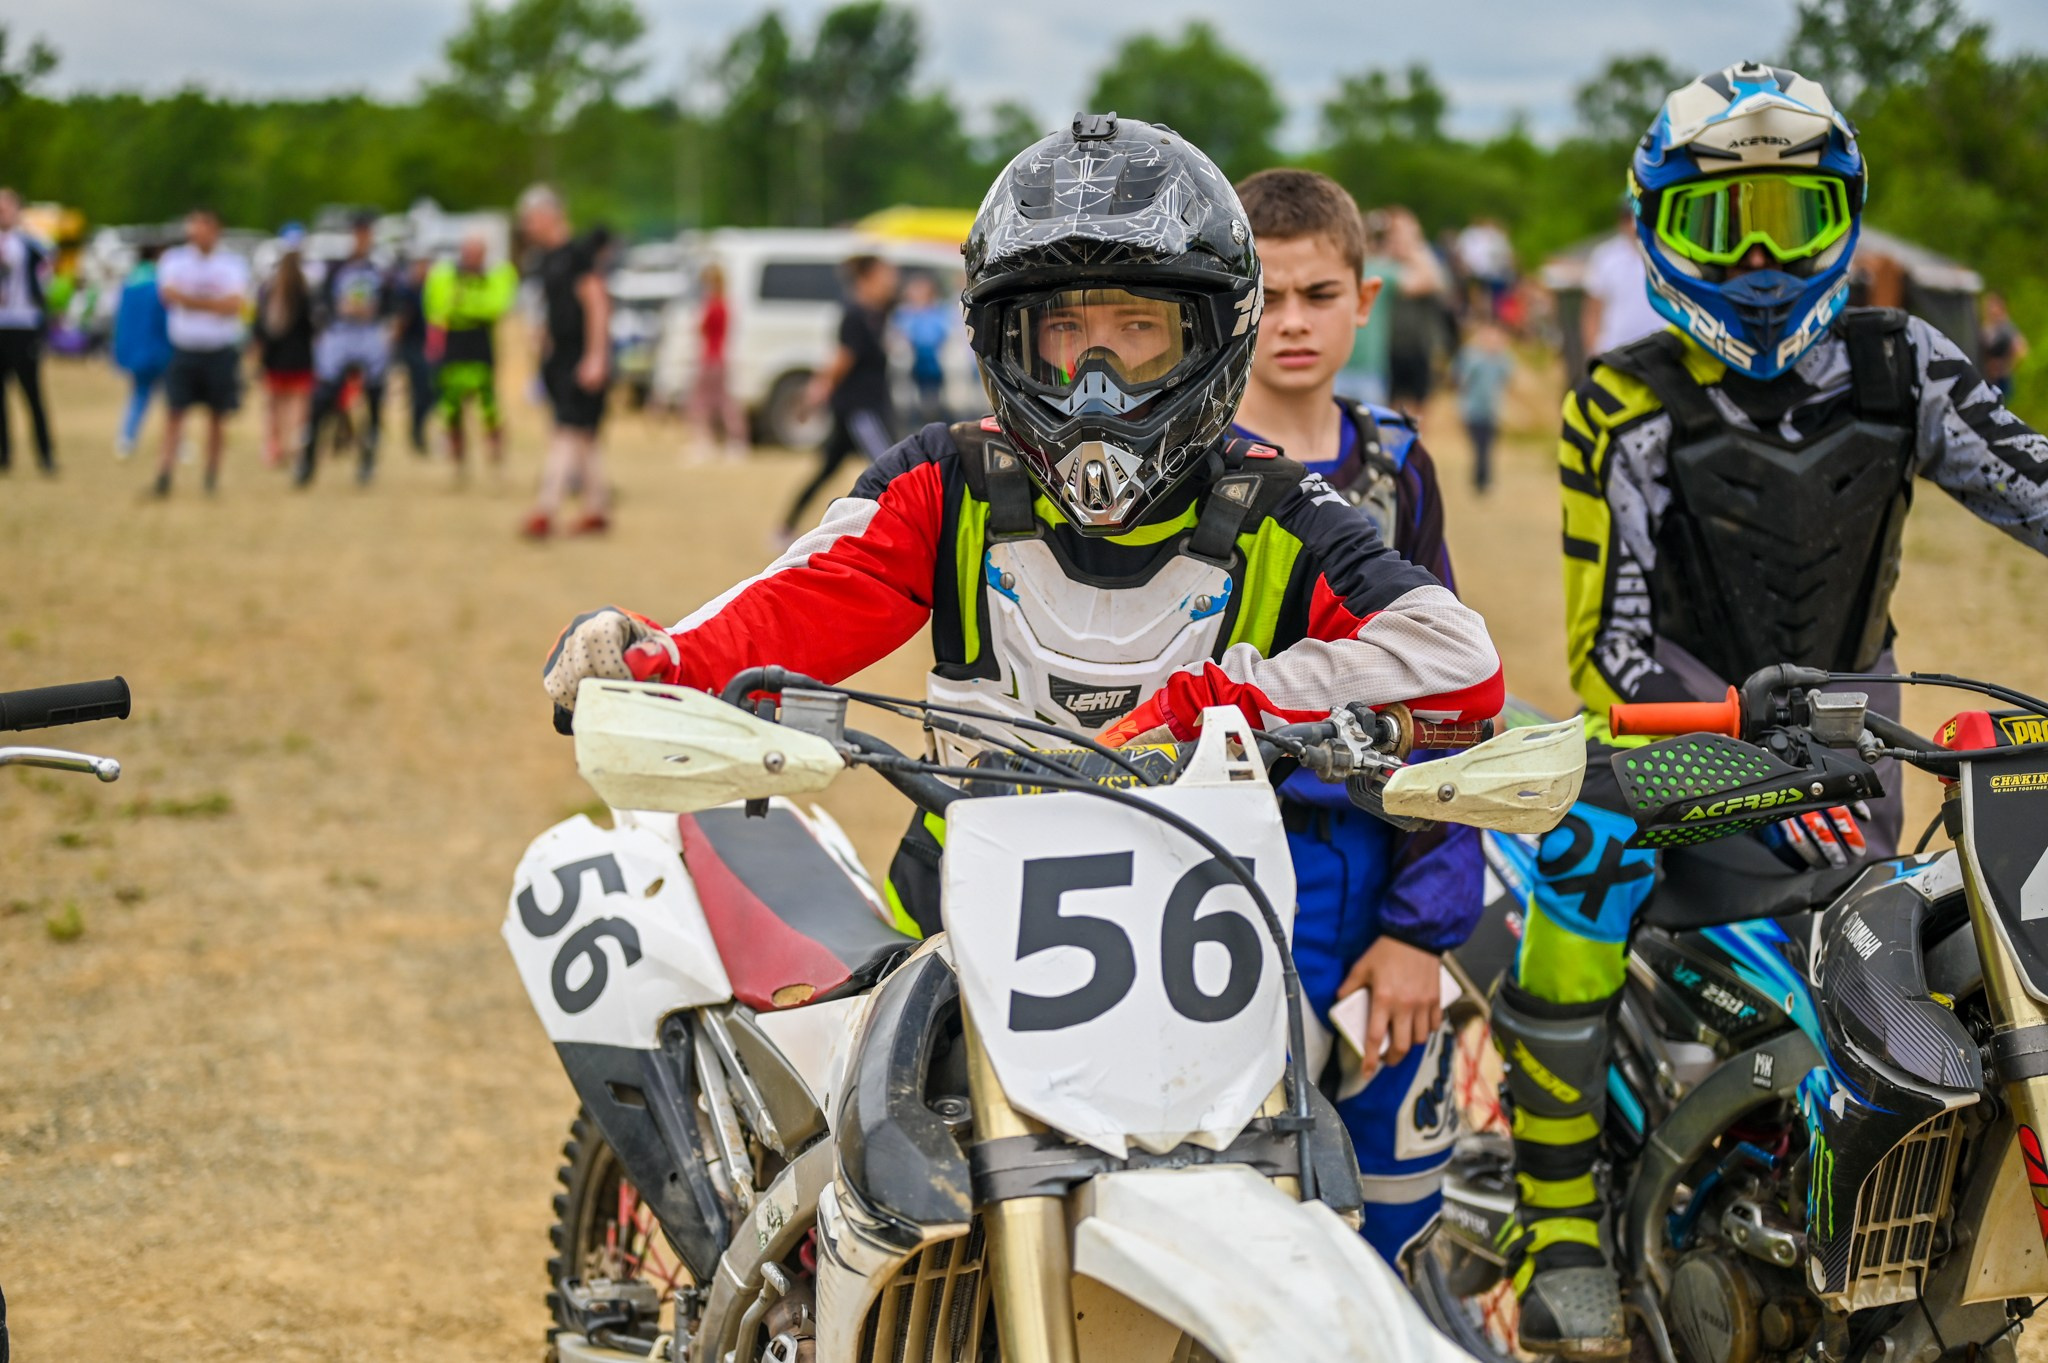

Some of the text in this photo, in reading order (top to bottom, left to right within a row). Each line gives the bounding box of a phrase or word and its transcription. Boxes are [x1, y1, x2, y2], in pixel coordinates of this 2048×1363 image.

[1065, 689, 1131, 713] LEATT
[1536, 812, 1655, 924] OX
[517, 853, 643, 1014] 56
[1008, 850, 1264, 1032] 56
[1846, 917, 1883, 961] YAMAHA
